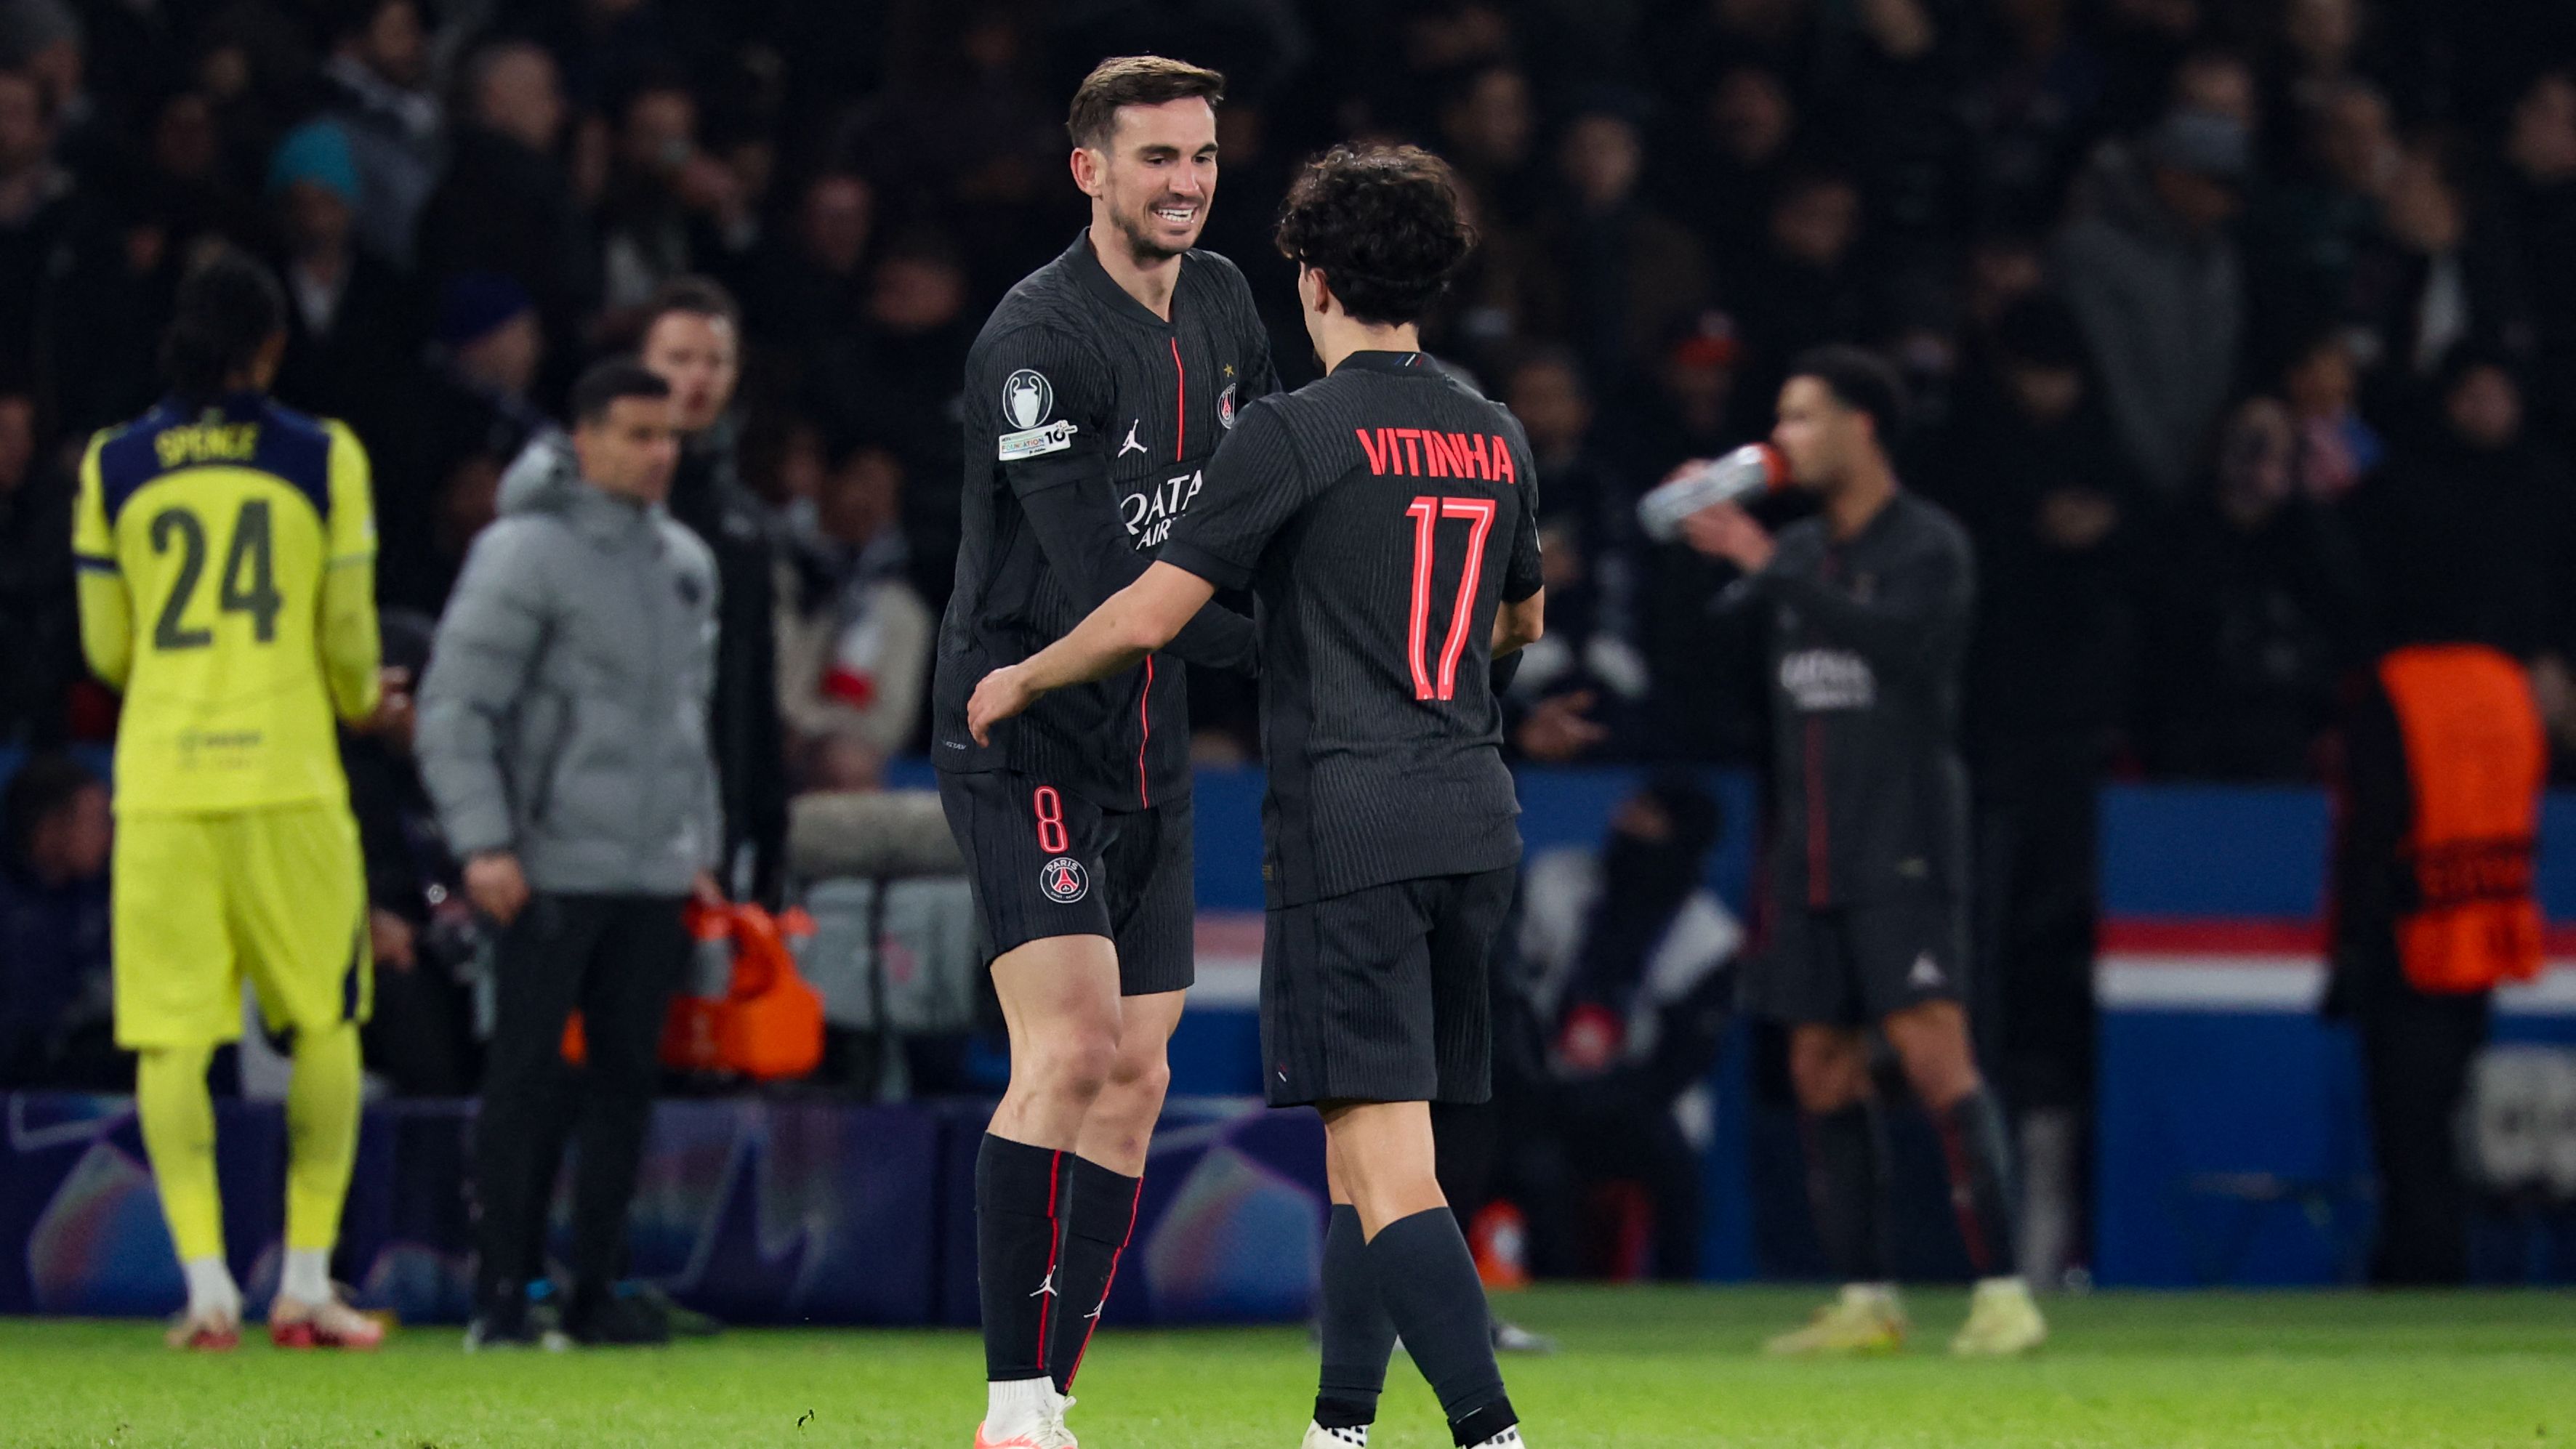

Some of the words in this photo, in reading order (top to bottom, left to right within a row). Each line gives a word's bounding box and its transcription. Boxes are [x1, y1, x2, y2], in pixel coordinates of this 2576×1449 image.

[155, 422, 257, 468] SPENCE
[1045, 430, 1066, 445] 10
[1356, 428, 1516, 484] VITINHA
[1120, 469, 1203, 536] QATA
[1135, 514, 1183, 550] AIR
[150, 500, 283, 650] 24
[1405, 496, 1497, 701] 17
[1034, 785, 1069, 855] 8
[1047, 859, 1078, 872] PARIS
